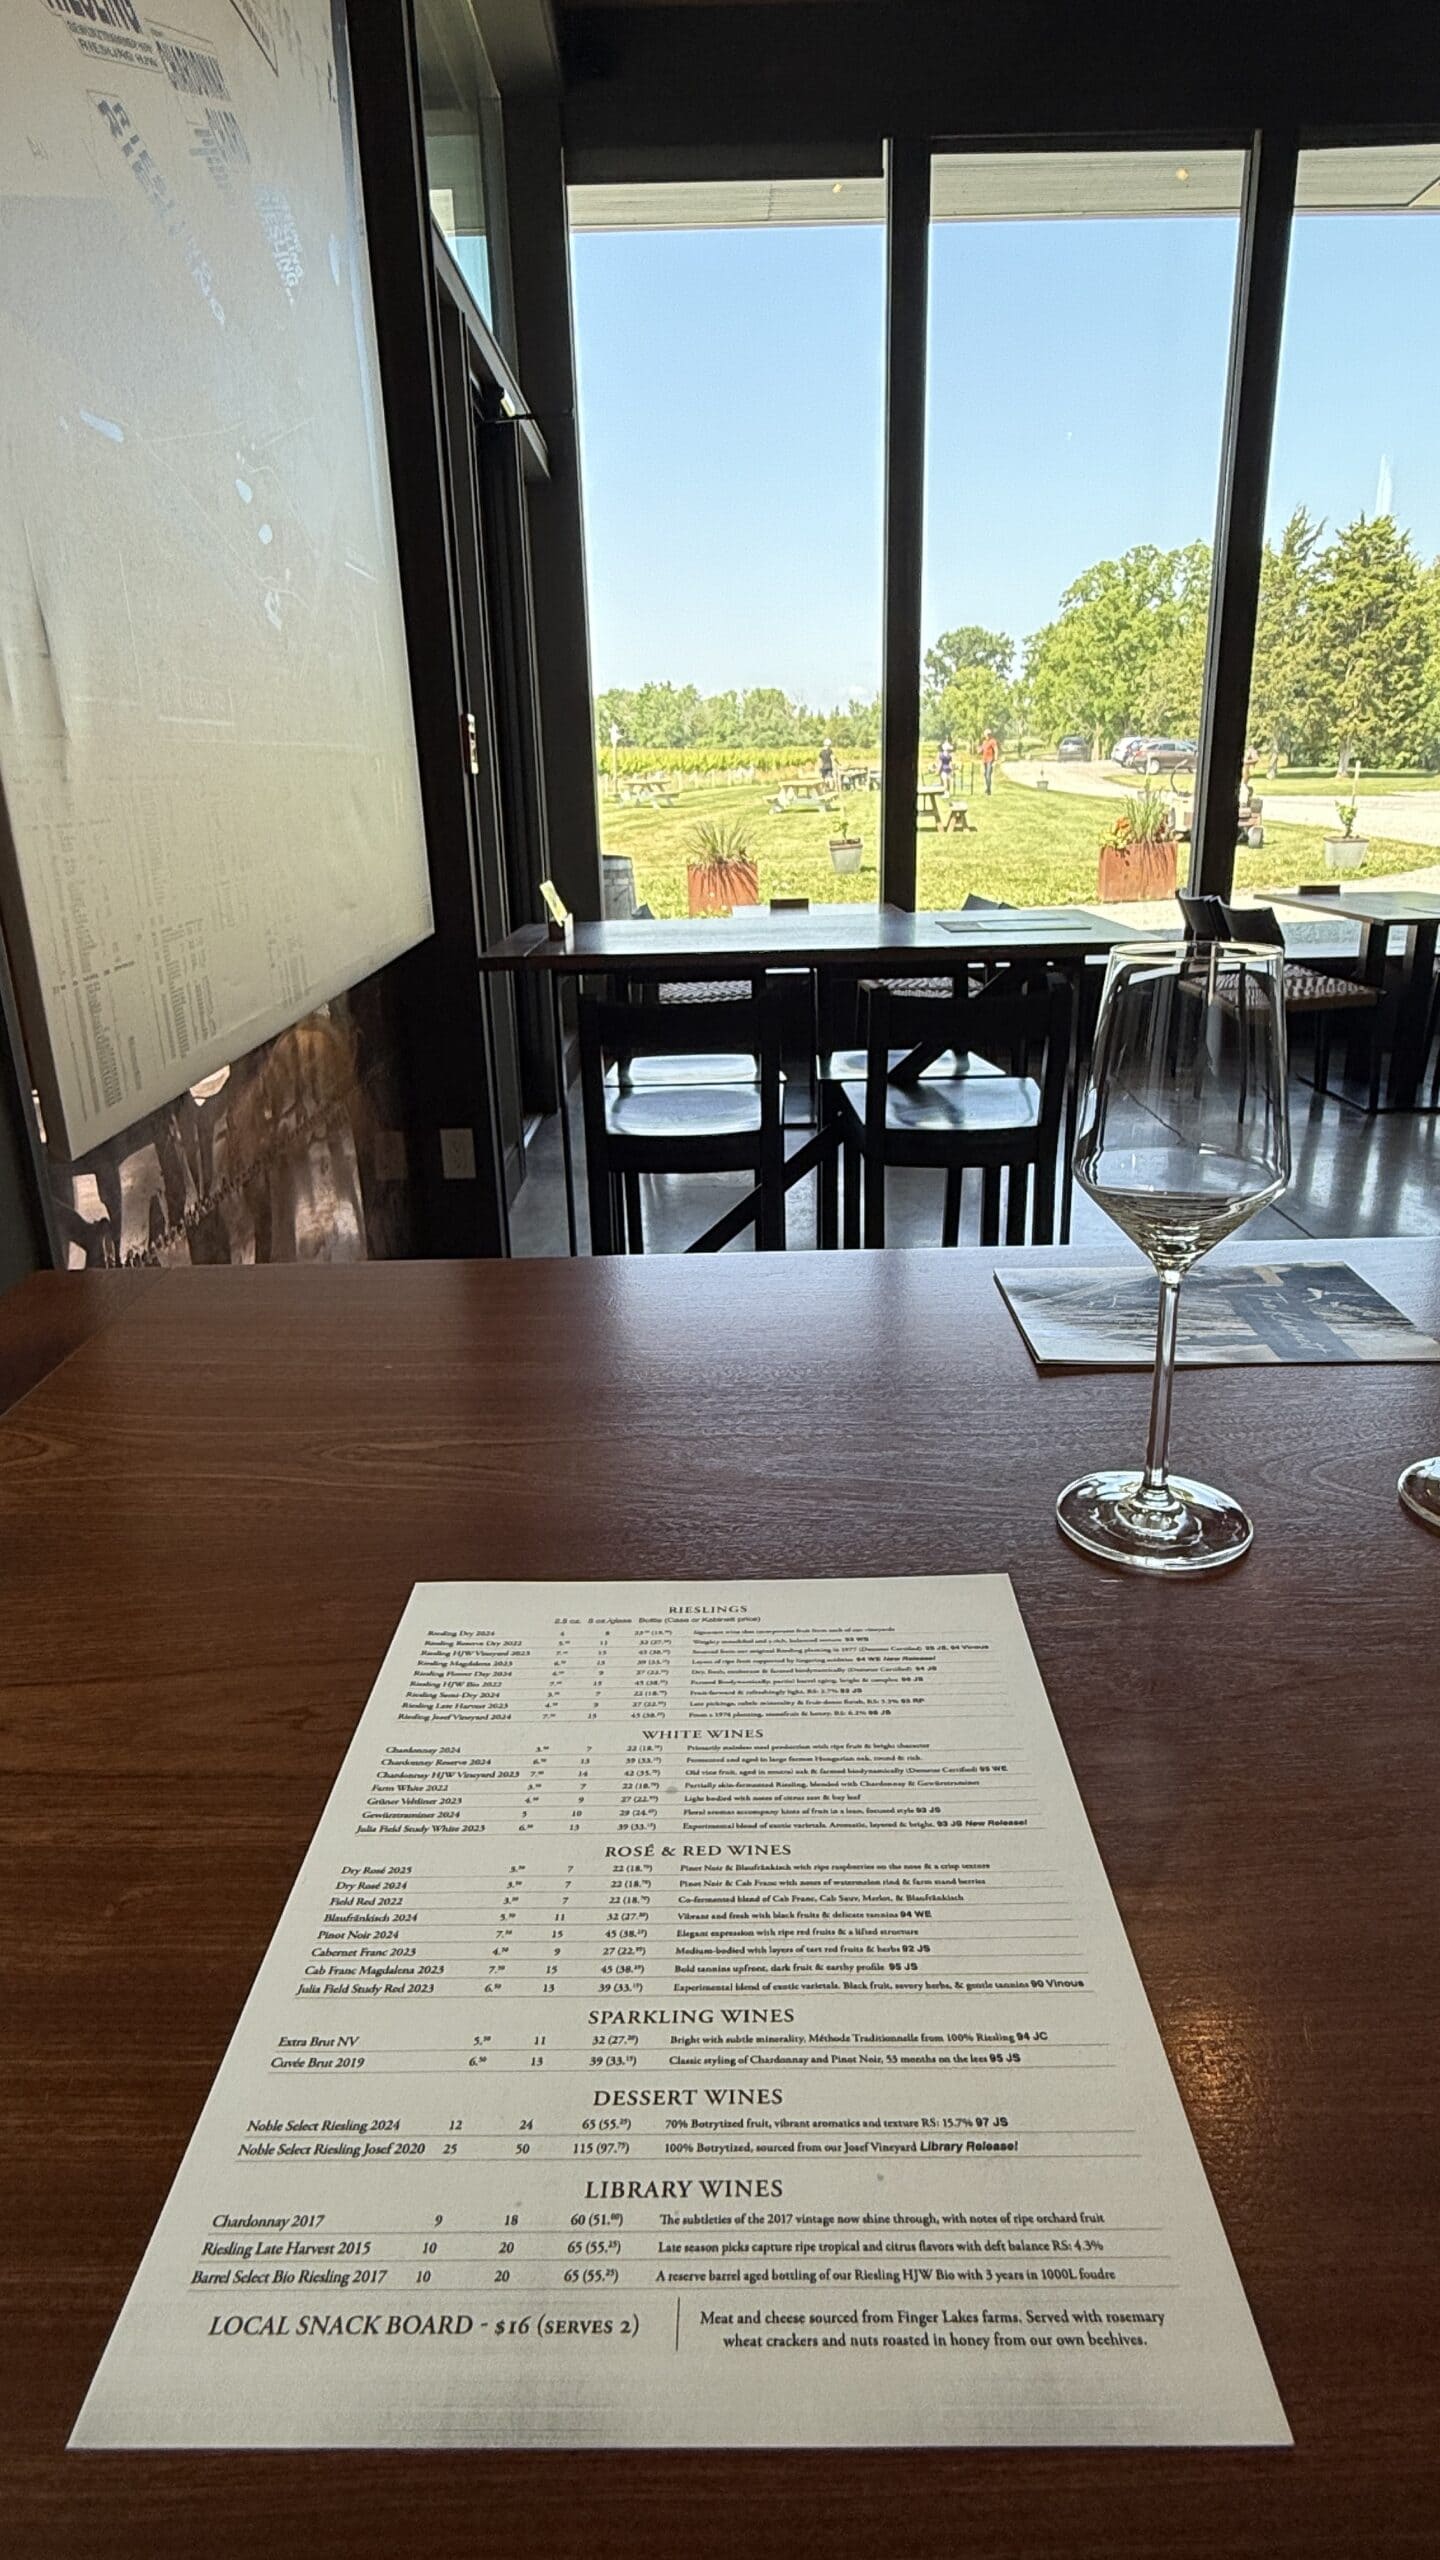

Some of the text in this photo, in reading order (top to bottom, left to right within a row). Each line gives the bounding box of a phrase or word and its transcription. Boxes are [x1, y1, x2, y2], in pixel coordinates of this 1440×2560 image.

[669, 1605, 747, 1613] RIESLINGS
[642, 1729, 763, 1739] WHITE WINES
[605, 1843, 791, 1857] ROSÉ & RED WINES
[341, 1866, 412, 1876] Dry Rosé 2025
[329, 1897, 403, 1905] Field Red 2022
[323, 1913, 417, 1922] Blaufränkisch 2024
[317, 1930, 399, 1939] Pinot Noir 2024
[311, 1947, 416, 1957] Cabernet Franc 2023
[304, 1965, 444, 1977] Cab Franc Magdalena 2023
[295, 1983, 434, 1996] Julia Field Study Red 2023
[588, 2008, 794, 2024] SPARKLING WINES
[278, 2036, 360, 2047] Extra Brut NV
[534, 2036, 545, 2045] 11
[270, 2057, 365, 2068] Cuvée Brut 2019
[531, 2057, 543, 2066] 13
[593, 2088, 782, 2106] DESSERT WINES
[246, 2119, 400, 2134] Noble Select Riesling 2024
[449, 2120, 462, 2130] 12
[519, 2119, 533, 2130] 24
[582, 2118, 595, 2130] 65
[666, 2119, 688, 2128] 70%
[690, 2118, 743, 2131] Botrytized
[746, 2118, 772, 2129] fruit,
[774, 2118, 809, 2128] vibrant
[812, 2119, 860, 2128] aromatics
[862, 2117, 881, 2127] and
[975, 2117, 989, 2127] 97
[993, 2116, 1008, 2127] JS
[237, 2142, 425, 2158] Noble Select Riesling Josef 2020
[442, 2143, 457, 2154] 25
[515, 2143, 530, 2154] 50
[573, 2143, 593, 2154] 115
[665, 2143, 693, 2152] 100%
[696, 2142, 753, 2155] Botrytized,
[756, 2142, 794, 2152] sourced
[797, 2141, 822, 2152] from
[843, 2141, 869, 2154] Josef
[870, 2141, 917, 2154] Vineyard
[920, 2141, 963, 2154] Library
[966, 2141, 1018, 2152] Release!
[585, 2179, 782, 2198] LIBRARY WINES
[212, 2214, 325, 2231] Chardonnay 2017
[434, 2214, 443, 2227] 9
[504, 2215, 518, 2226] 18
[570, 2213, 586, 2225] 60
[659, 2211, 1105, 2227] The subtleties of the 2017 vintage now shine through, with notes of ripe orchard fruit
[201, 2241, 371, 2259] Riesling Late Harvest 2015
[422, 2242, 437, 2254] 10
[498, 2242, 514, 2253] 20
[567, 2241, 582, 2254] 65
[191, 2269, 387, 2288] Barrel Select Bio Riesling 2017
[416, 2270, 431, 2283] 10
[494, 2270, 510, 2282] 20
[564, 2269, 579, 2283] 65
[700, 2309, 1164, 2328] Meat and cheese sourced from Finger Lakes farms. Served with rosemary
[208, 2316, 289, 2335] LOCAL
[295, 2315, 381, 2335] SNACK
[385, 2315, 473, 2335] BOARD
[494, 2316, 531, 2336] $16
[537, 2313, 613, 2337] (SERVES
[620, 2314, 639, 2337] 2)
[723, 2331, 1147, 2350] wheat crackers and nuts roasted in honey from our own beehives.
